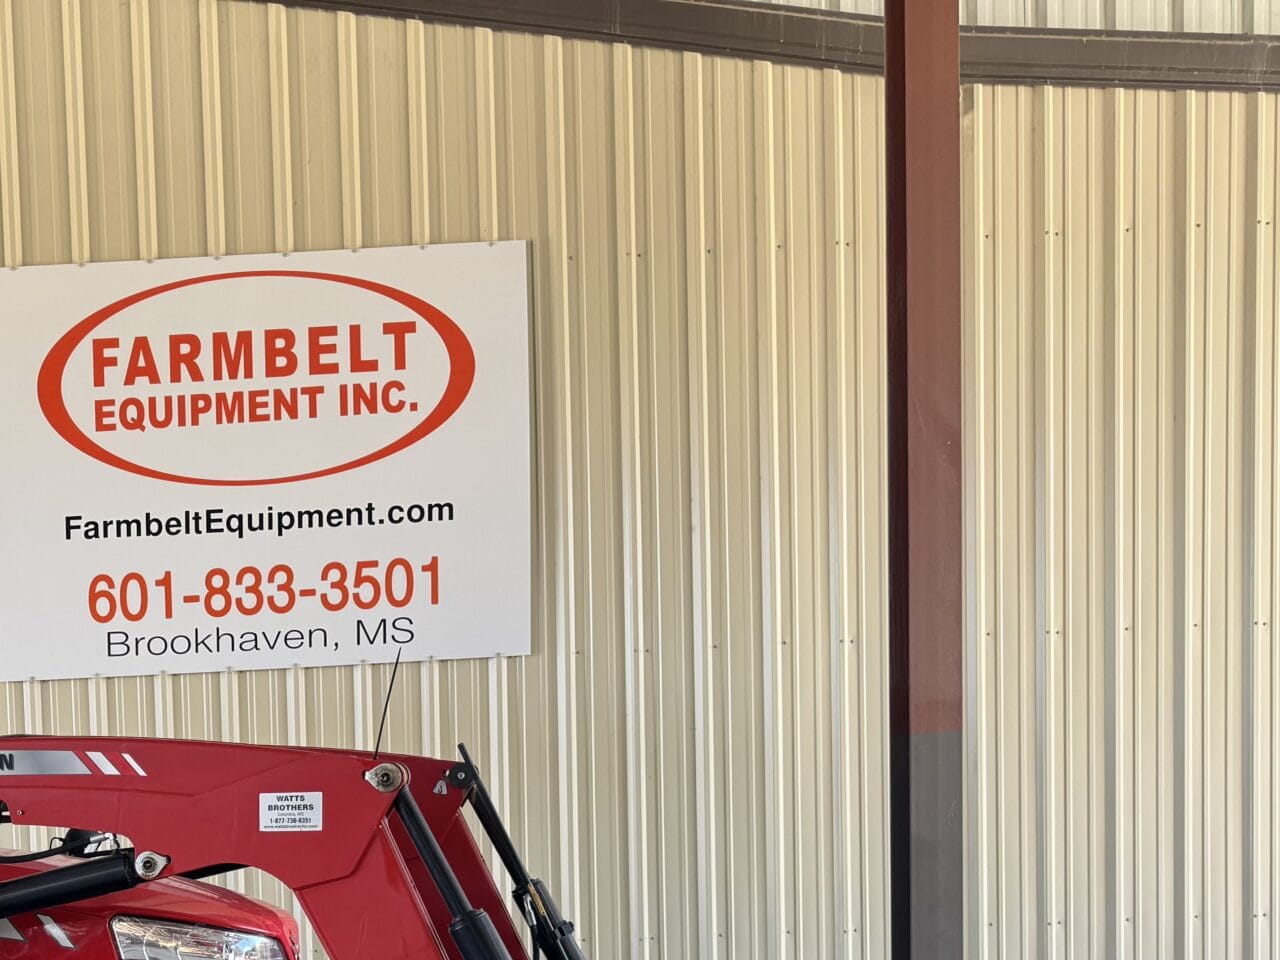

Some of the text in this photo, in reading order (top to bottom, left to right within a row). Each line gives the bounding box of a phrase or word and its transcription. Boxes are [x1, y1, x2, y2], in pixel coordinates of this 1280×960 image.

[92, 320, 417, 388] FARMBELT
[94, 380, 418, 433] EQUIPMENT INC.
[64, 501, 454, 541] FarmbeltEquipment.com
[88, 556, 440, 624] 601-833-3501
[106, 616, 415, 657] Brookhaven, MS
